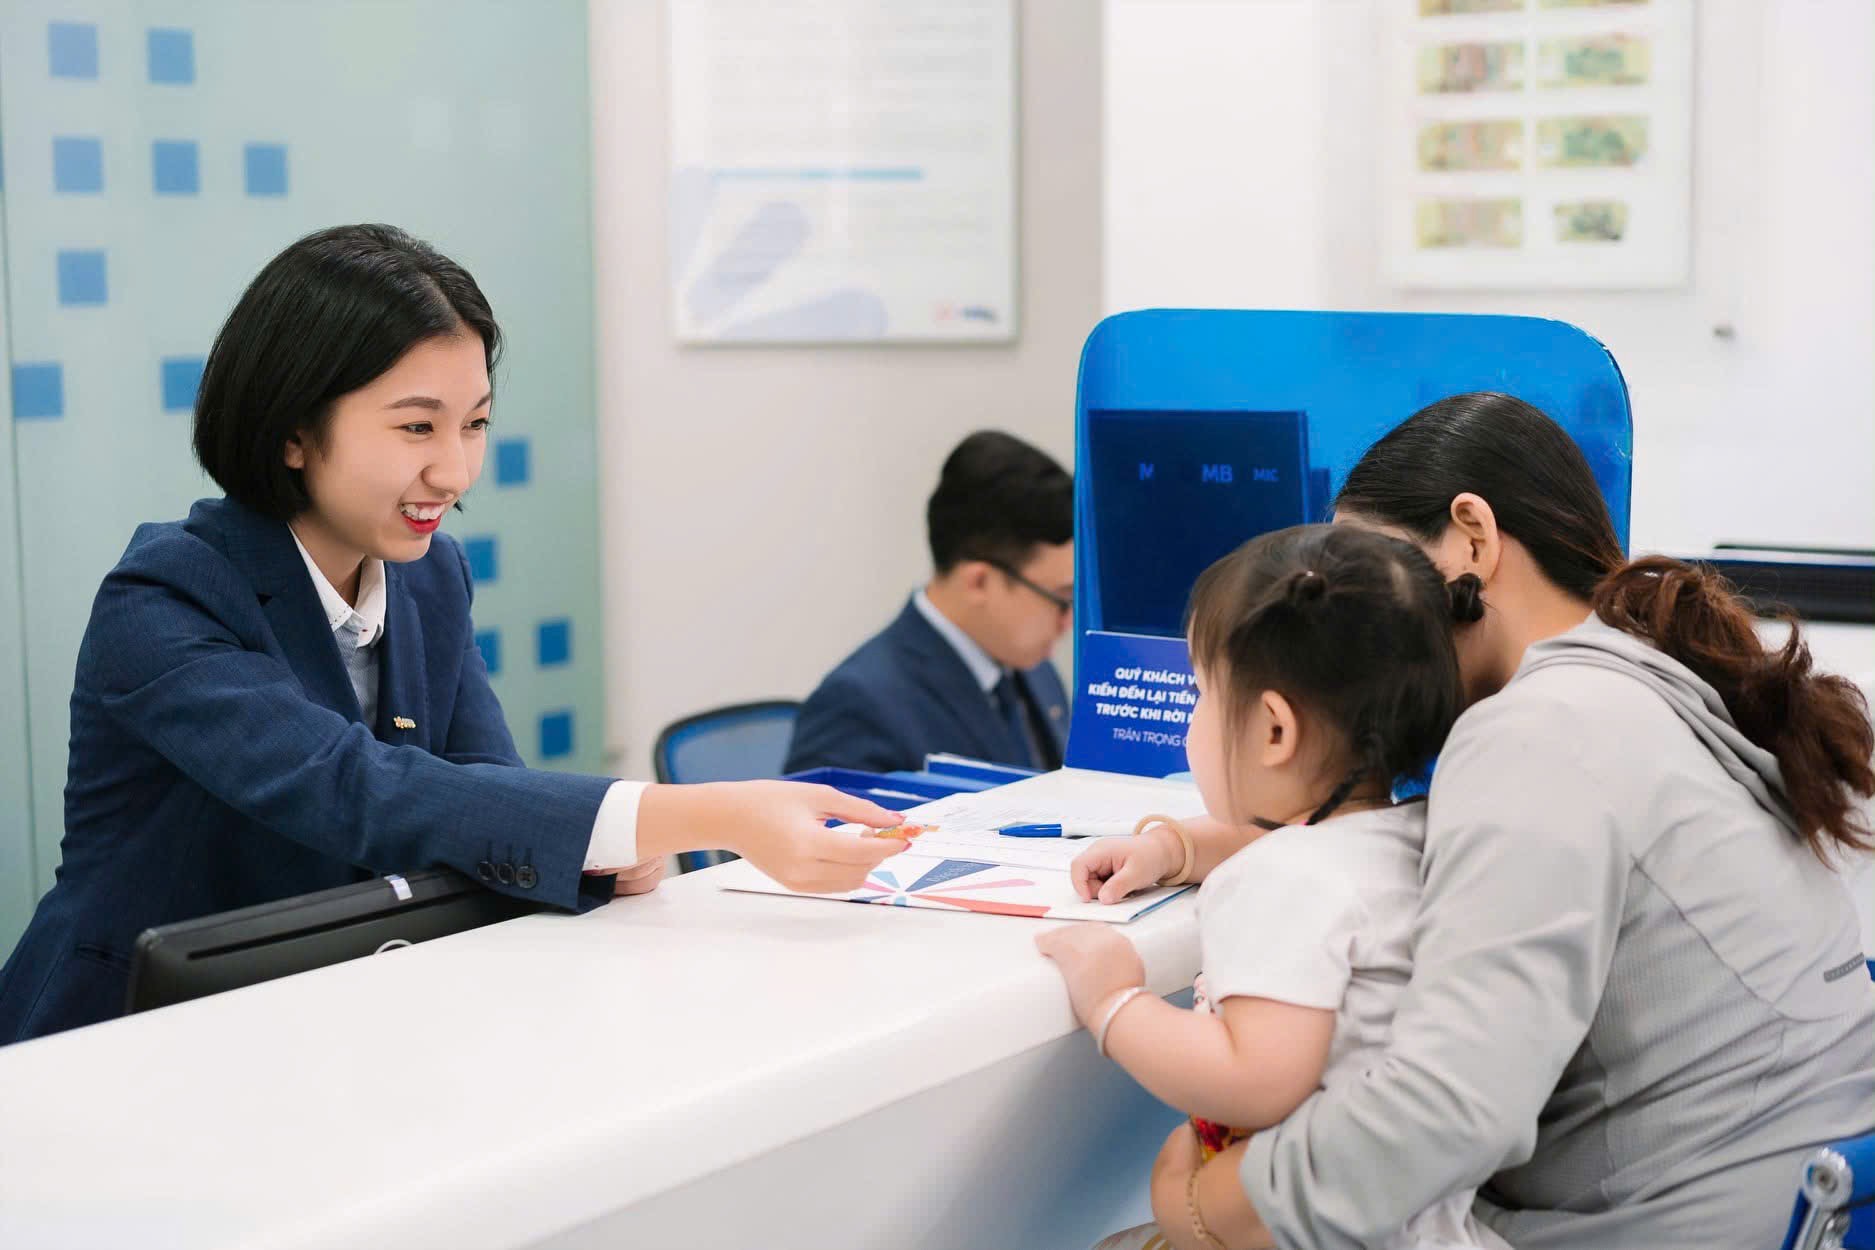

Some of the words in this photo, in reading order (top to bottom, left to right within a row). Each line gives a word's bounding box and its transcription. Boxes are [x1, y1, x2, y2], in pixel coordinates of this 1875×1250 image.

[1202, 463, 1233, 483] MB
[1142, 669, 1186, 686] KHÁCH
[1147, 689, 1167, 704] LẠI
[1096, 702, 1139, 718] TRƯỚC
[1140, 707, 1162, 721] KHI
[1142, 731, 1181, 747] TRỌNG
